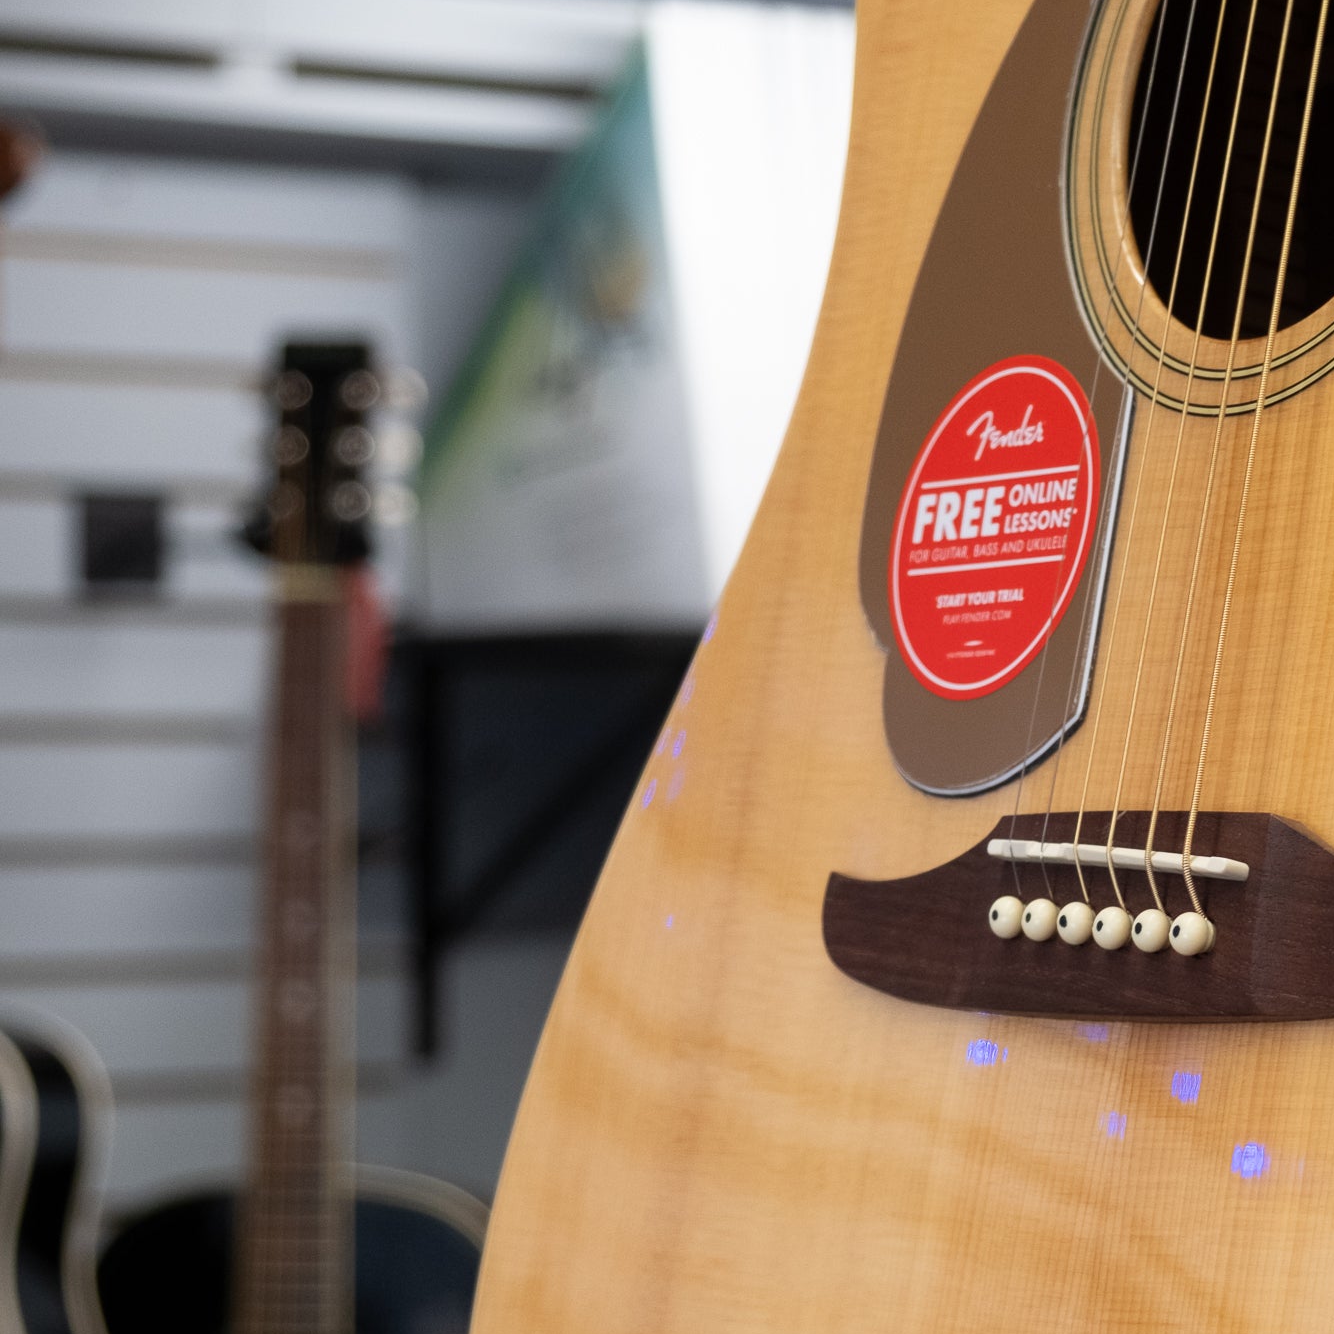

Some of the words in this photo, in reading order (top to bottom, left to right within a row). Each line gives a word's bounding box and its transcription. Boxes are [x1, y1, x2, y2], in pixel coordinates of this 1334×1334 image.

[966, 404, 1044, 461] Fender
[1008, 478, 1078, 507] ONLINE
[912, 486, 1006, 544] FREE
[909, 549, 930, 563] FOR
[973, 542, 998, 558] BASS
[1000, 539, 1025, 554] AND
[936, 593, 967, 609] START
[967, 590, 996, 606] YOUR
[997, 588, 1024, 603] TRIAL
